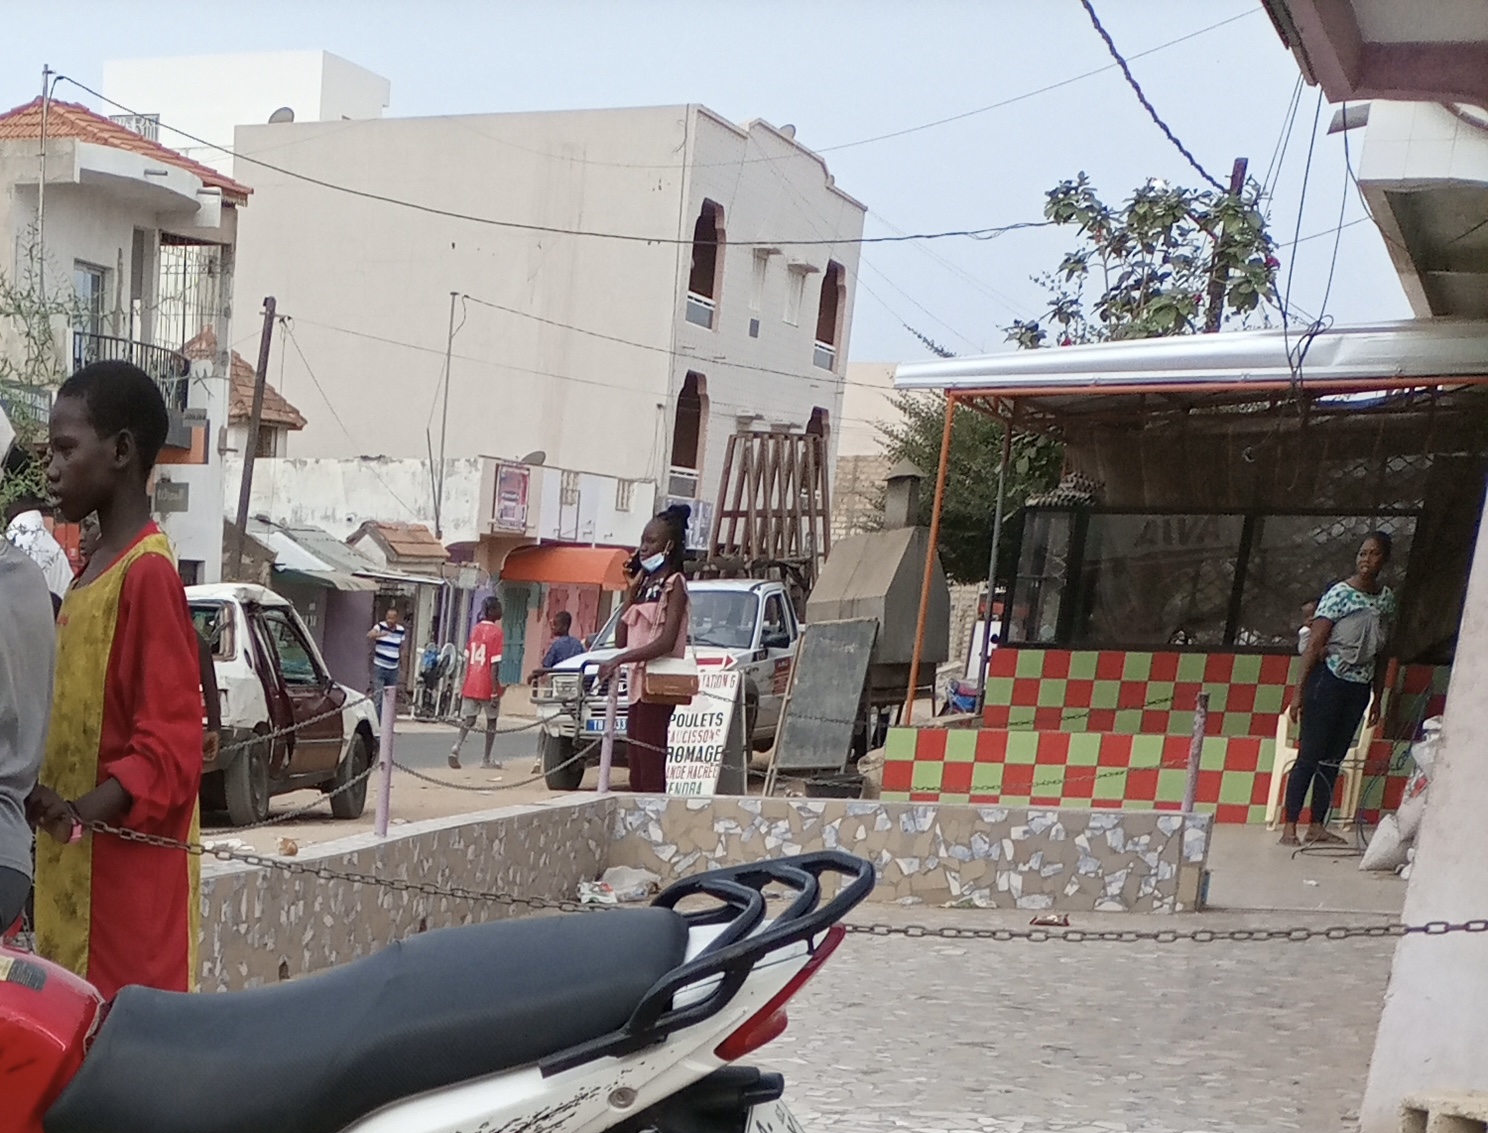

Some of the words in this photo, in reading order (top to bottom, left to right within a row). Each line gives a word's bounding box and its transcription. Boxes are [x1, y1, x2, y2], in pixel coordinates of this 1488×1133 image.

[470, 642, 486, 666] 14
[670, 712, 724, 728] POULETS
[668, 729, 721, 744] AUCISSONS
[666, 745, 723, 763] ROMAGE
